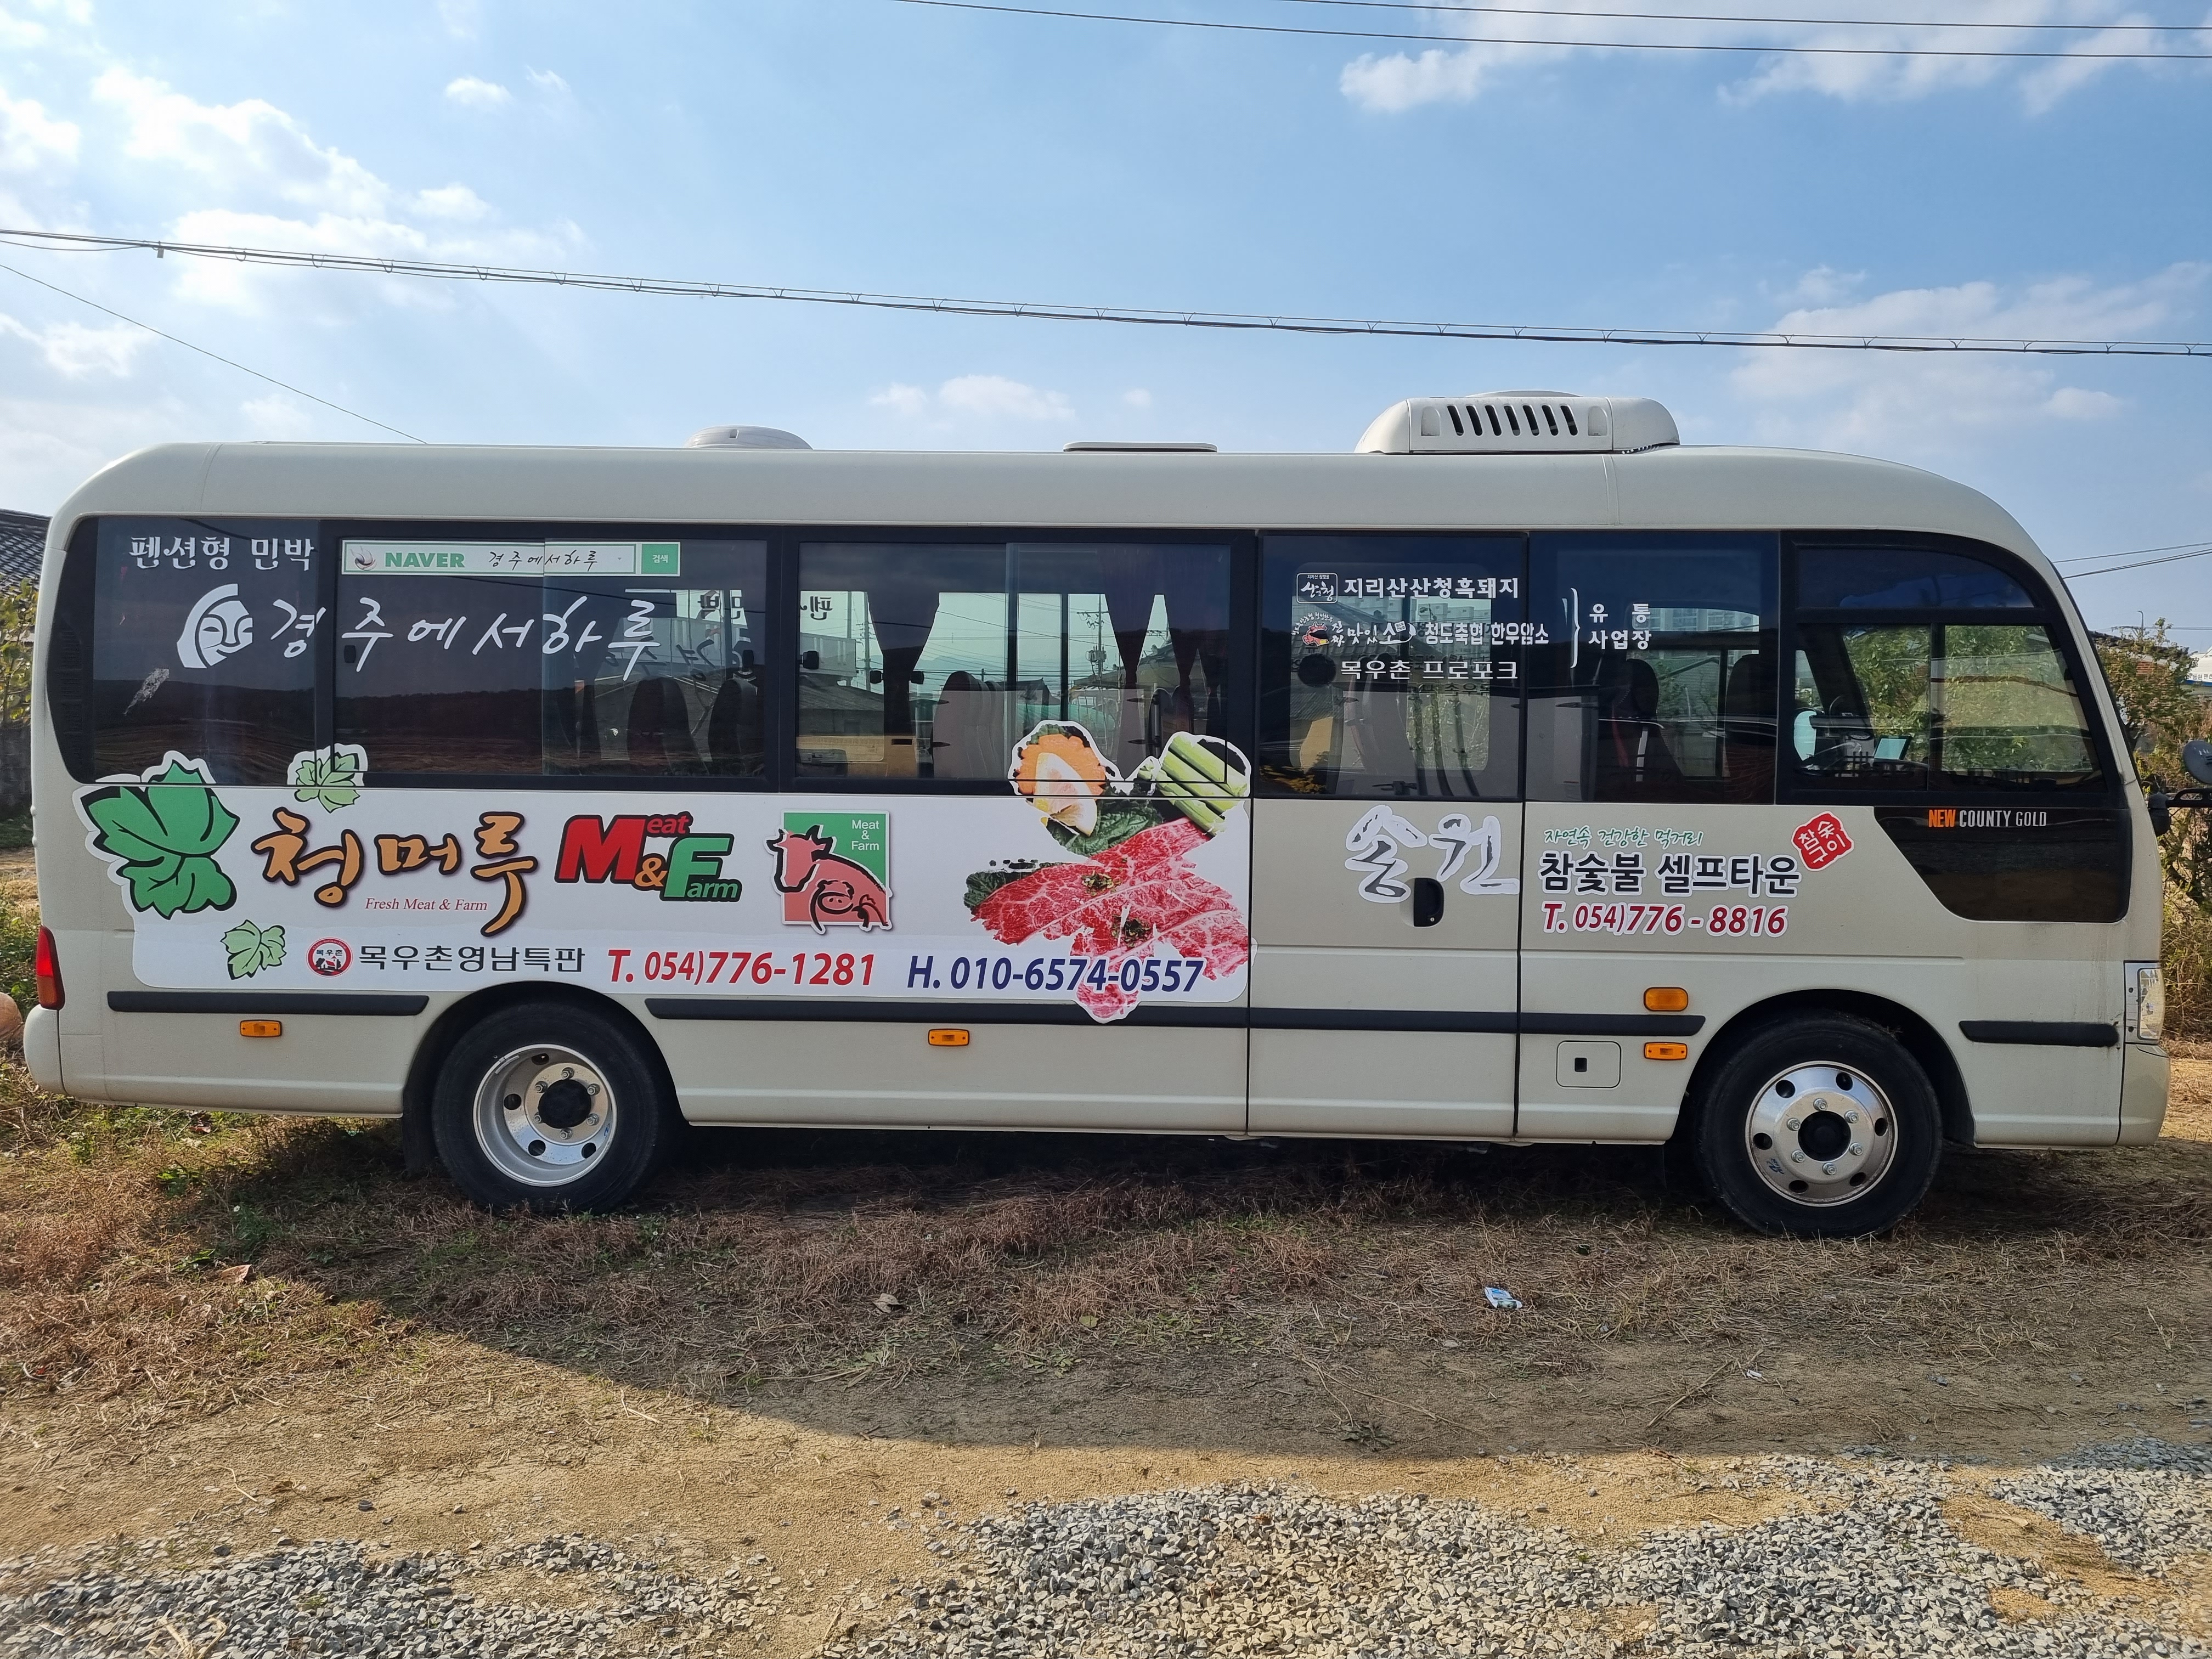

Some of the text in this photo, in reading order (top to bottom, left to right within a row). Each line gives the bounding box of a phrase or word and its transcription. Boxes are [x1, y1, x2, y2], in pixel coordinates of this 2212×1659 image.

[129, 537, 314, 571] 펜션형 민박
[385, 552, 465, 567] NAVER
[652, 554, 668, 563] 검색
[1344, 578, 1519, 599] 지리산산청흑돼지
[1425, 622, 1483, 645] 청도축협
[1491, 622, 1549, 645] 한우암소
[1588, 629, 1652, 650] 사업장
[1340, 659, 1411, 680] 목우촌
[1422, 661, 1518, 679] 프로포크
[851, 820, 879, 830] Meat
[1928, 809, 2047, 827] NEW COUNTY GOLD
[851, 841, 879, 850] Farm
[861, 831, 870, 840] &
[1545, 826, 1705, 849] 자연속 건강한 먹거리
[251, 807, 538, 936] 청머루
[1540, 853, 1799, 895] 참숯불 셀프타운
[365, 898, 487, 911] Fresh Meat & Farm
[1543, 903, 1566, 931] T.
[359, 945, 585, 973] 목우촌영남특판
[609, 949, 874, 986] T. 054)776-1281
[907, 955, 1204, 993] H. 010-6574-0557
